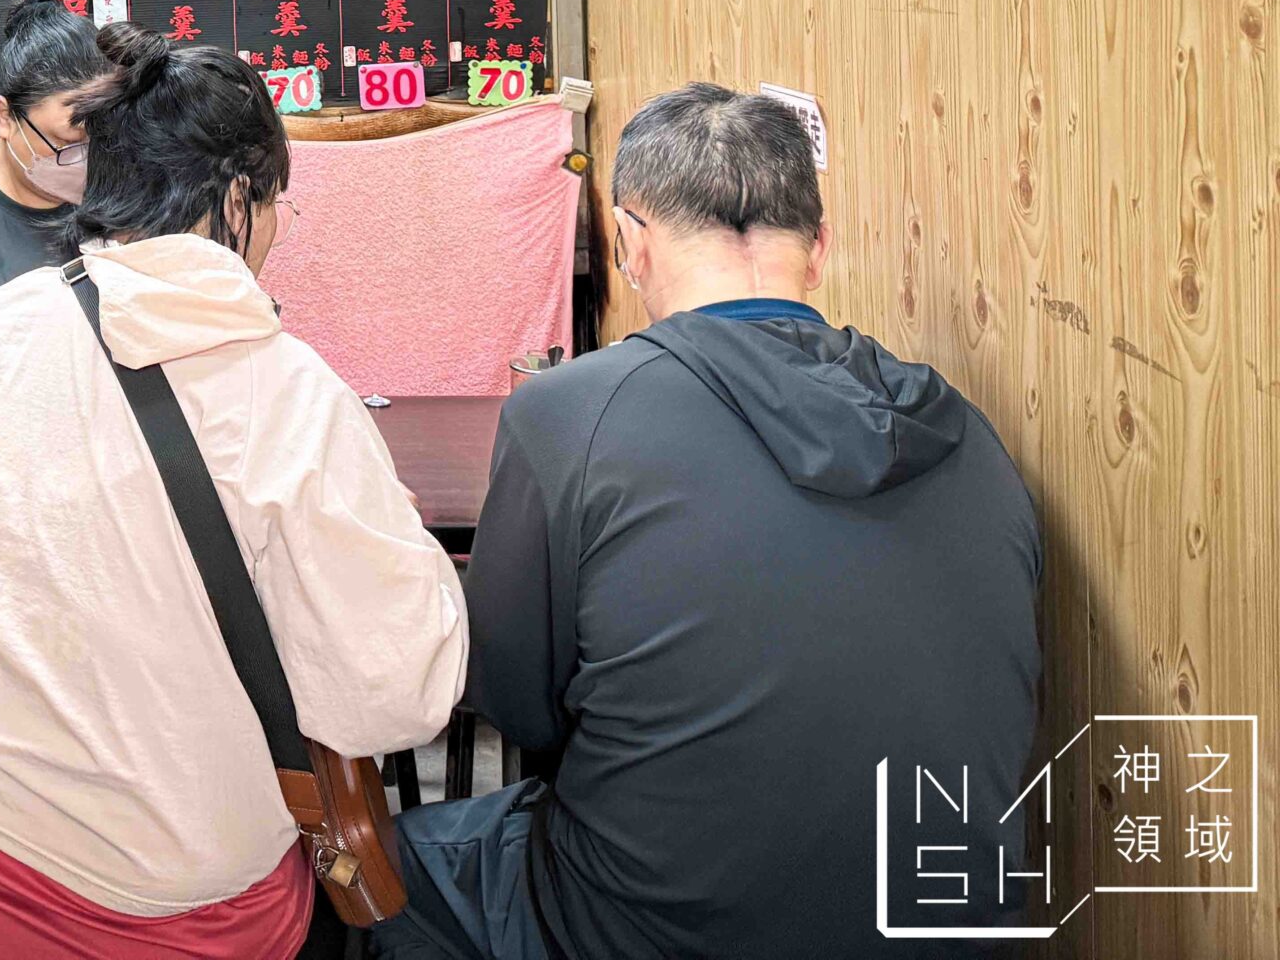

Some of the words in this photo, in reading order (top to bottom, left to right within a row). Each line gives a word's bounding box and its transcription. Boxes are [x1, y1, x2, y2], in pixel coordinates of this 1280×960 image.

[250, 52, 266, 66] 飯
[271, 44, 288, 70] 米粉
[293, 50, 310, 65] 麵
[314, 42, 331, 71] 冬粉
[356, 48, 373, 62] 飯
[377, 40, 394, 64] 米粉
[399, 46, 416, 61] 麵
[421, 39, 438, 67] 冬粉
[463, 44, 480, 59] 飯
[485, 37, 502, 62] 米粉
[506, 43, 524, 59] 麵
[529, 35, 545, 65] 冬粉
[267, 72, 315, 108] 70
[365, 68, 418, 106] 80
[476, 67, 526, 101] 70
